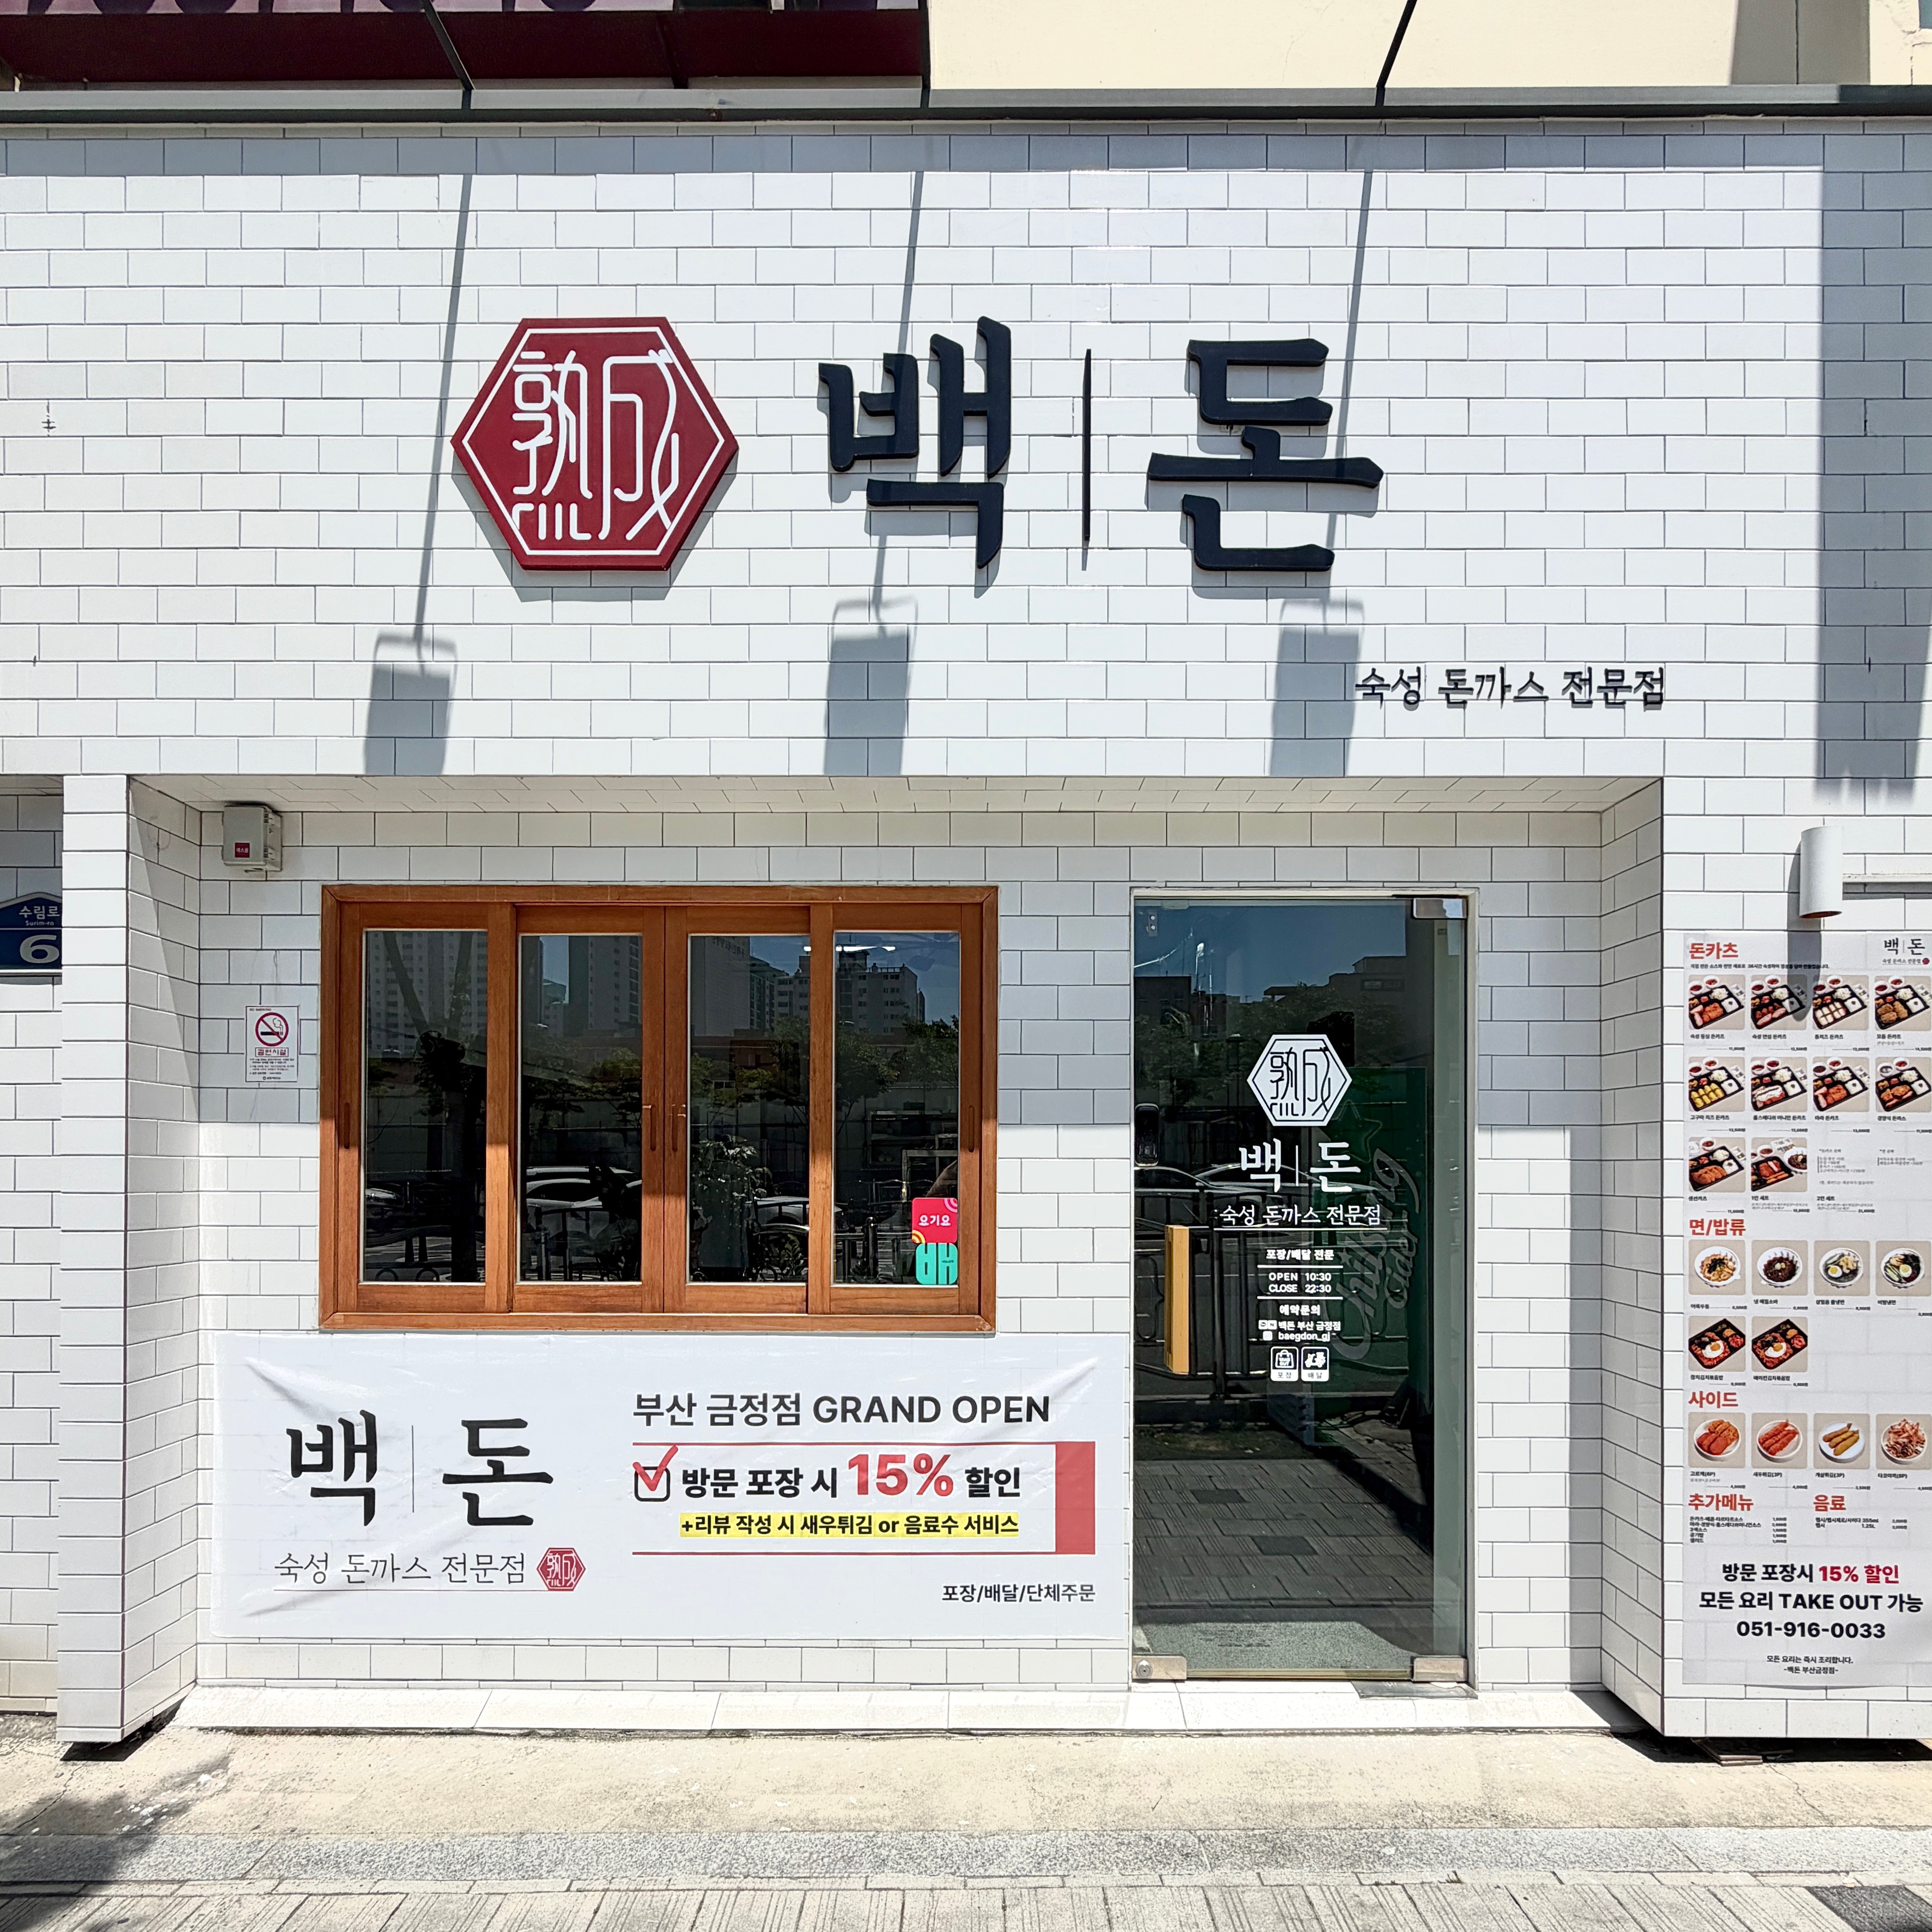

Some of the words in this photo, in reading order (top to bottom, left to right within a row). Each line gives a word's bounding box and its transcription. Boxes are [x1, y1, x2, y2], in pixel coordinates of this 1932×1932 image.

[818, 316, 1011, 569] 백
[1147, 339, 1383, 571] 돈
[1355, 666, 1421, 707] 숙성
[1438, 666, 1549, 708] 돈까스
[1562, 666, 1664, 707] 전문점
[19, 906, 60, 920] 수림로
[20, 935, 60, 963] 6
[1689, 942, 1739, 959] 돈카츠
[1884, 938, 1898, 954] 백
[1908, 939, 1925, 955] 돈
[1239, 1138, 1281, 1192] 백
[1310, 1142, 1361, 1192] 돈
[919, 1215, 951, 1226] 요기요
[1220, 1205, 1254, 1226] 숙성
[1262, 1205, 1321, 1225] 돈까스
[1326, 1204, 1381, 1225] 전문점
[1689, 1218, 1746, 1236] 면/밥류
[1266, 1249, 1311, 1260] 포장/배달
[1314, 1249, 1334, 1260] 전문
[1269, 1273, 1298, 1281] OPEN
[1305, 1272, 1331, 1281] 10:30
[1269, 1284, 1298, 1292] CLOSE
[1305, 1284, 1331, 1292] 22:30
[1279, 1305, 1321, 1316] 예약문의
[1279, 1321, 1295, 1331] 백돈
[1297, 1321, 1314, 1331] 부산
[1316, 1321, 1341, 1331] 금정점
[1278, 1332, 1330, 1342] baegdon_gj
[1688, 1391, 1738, 1408] 사이드
[634, 1393, 697, 1426] 부산
[707, 1393, 800, 1426] 금정점
[813, 1396, 941, 1422] GRAND
[953, 1396, 1049, 1423] OPEN
[287, 1410, 377, 1526] 백
[442, 1419, 553, 1526] 돈
[682, 1468, 738, 1498] 방문
[746, 1468, 803, 1498] 포장
[811, 1468, 836, 1498] 시
[848, 1453, 953, 1496] 15%
[965, 1467, 1020, 1497] 할인
[1688, 1494, 1753, 1511] 추가메뉴
[1813, 1494, 1846, 1512] 음료
[682, 1515, 731, 1534] +리뷰
[736, 1515, 771, 1534] 작성
[778, 1515, 794, 1534] 시
[801, 1515, 871, 1534] 새우튀김
[879, 1521, 899, 1532] or
[904, 1516, 959, 1534] 음료수
[964, 1515, 1019, 1534] 서비스
[275, 1552, 328, 1584] 숙성
[341, 1553, 431, 1583] 돈까스
[442, 1553, 524, 1584] 전문점
[1723, 1563, 1757, 1582] 방문
[1762, 1564, 1812, 1582] 포장시
[1819, 1566, 1859, 1583] 15%
[1864, 1565, 1899, 1584] 할인
[942, 1584, 1095, 1602] 포장/배달/단체주문
[1700, 1592, 1734, 1609] 모든
[1739, 1592, 1772, 1610] 요리
[1779, 1594, 1833, 1609] TAKE
[1840, 1595, 1882, 1610] OUT
[1888, 1594, 1923, 1612] 가능
[1737, 1622, 1885, 1638] 051-916-0033
